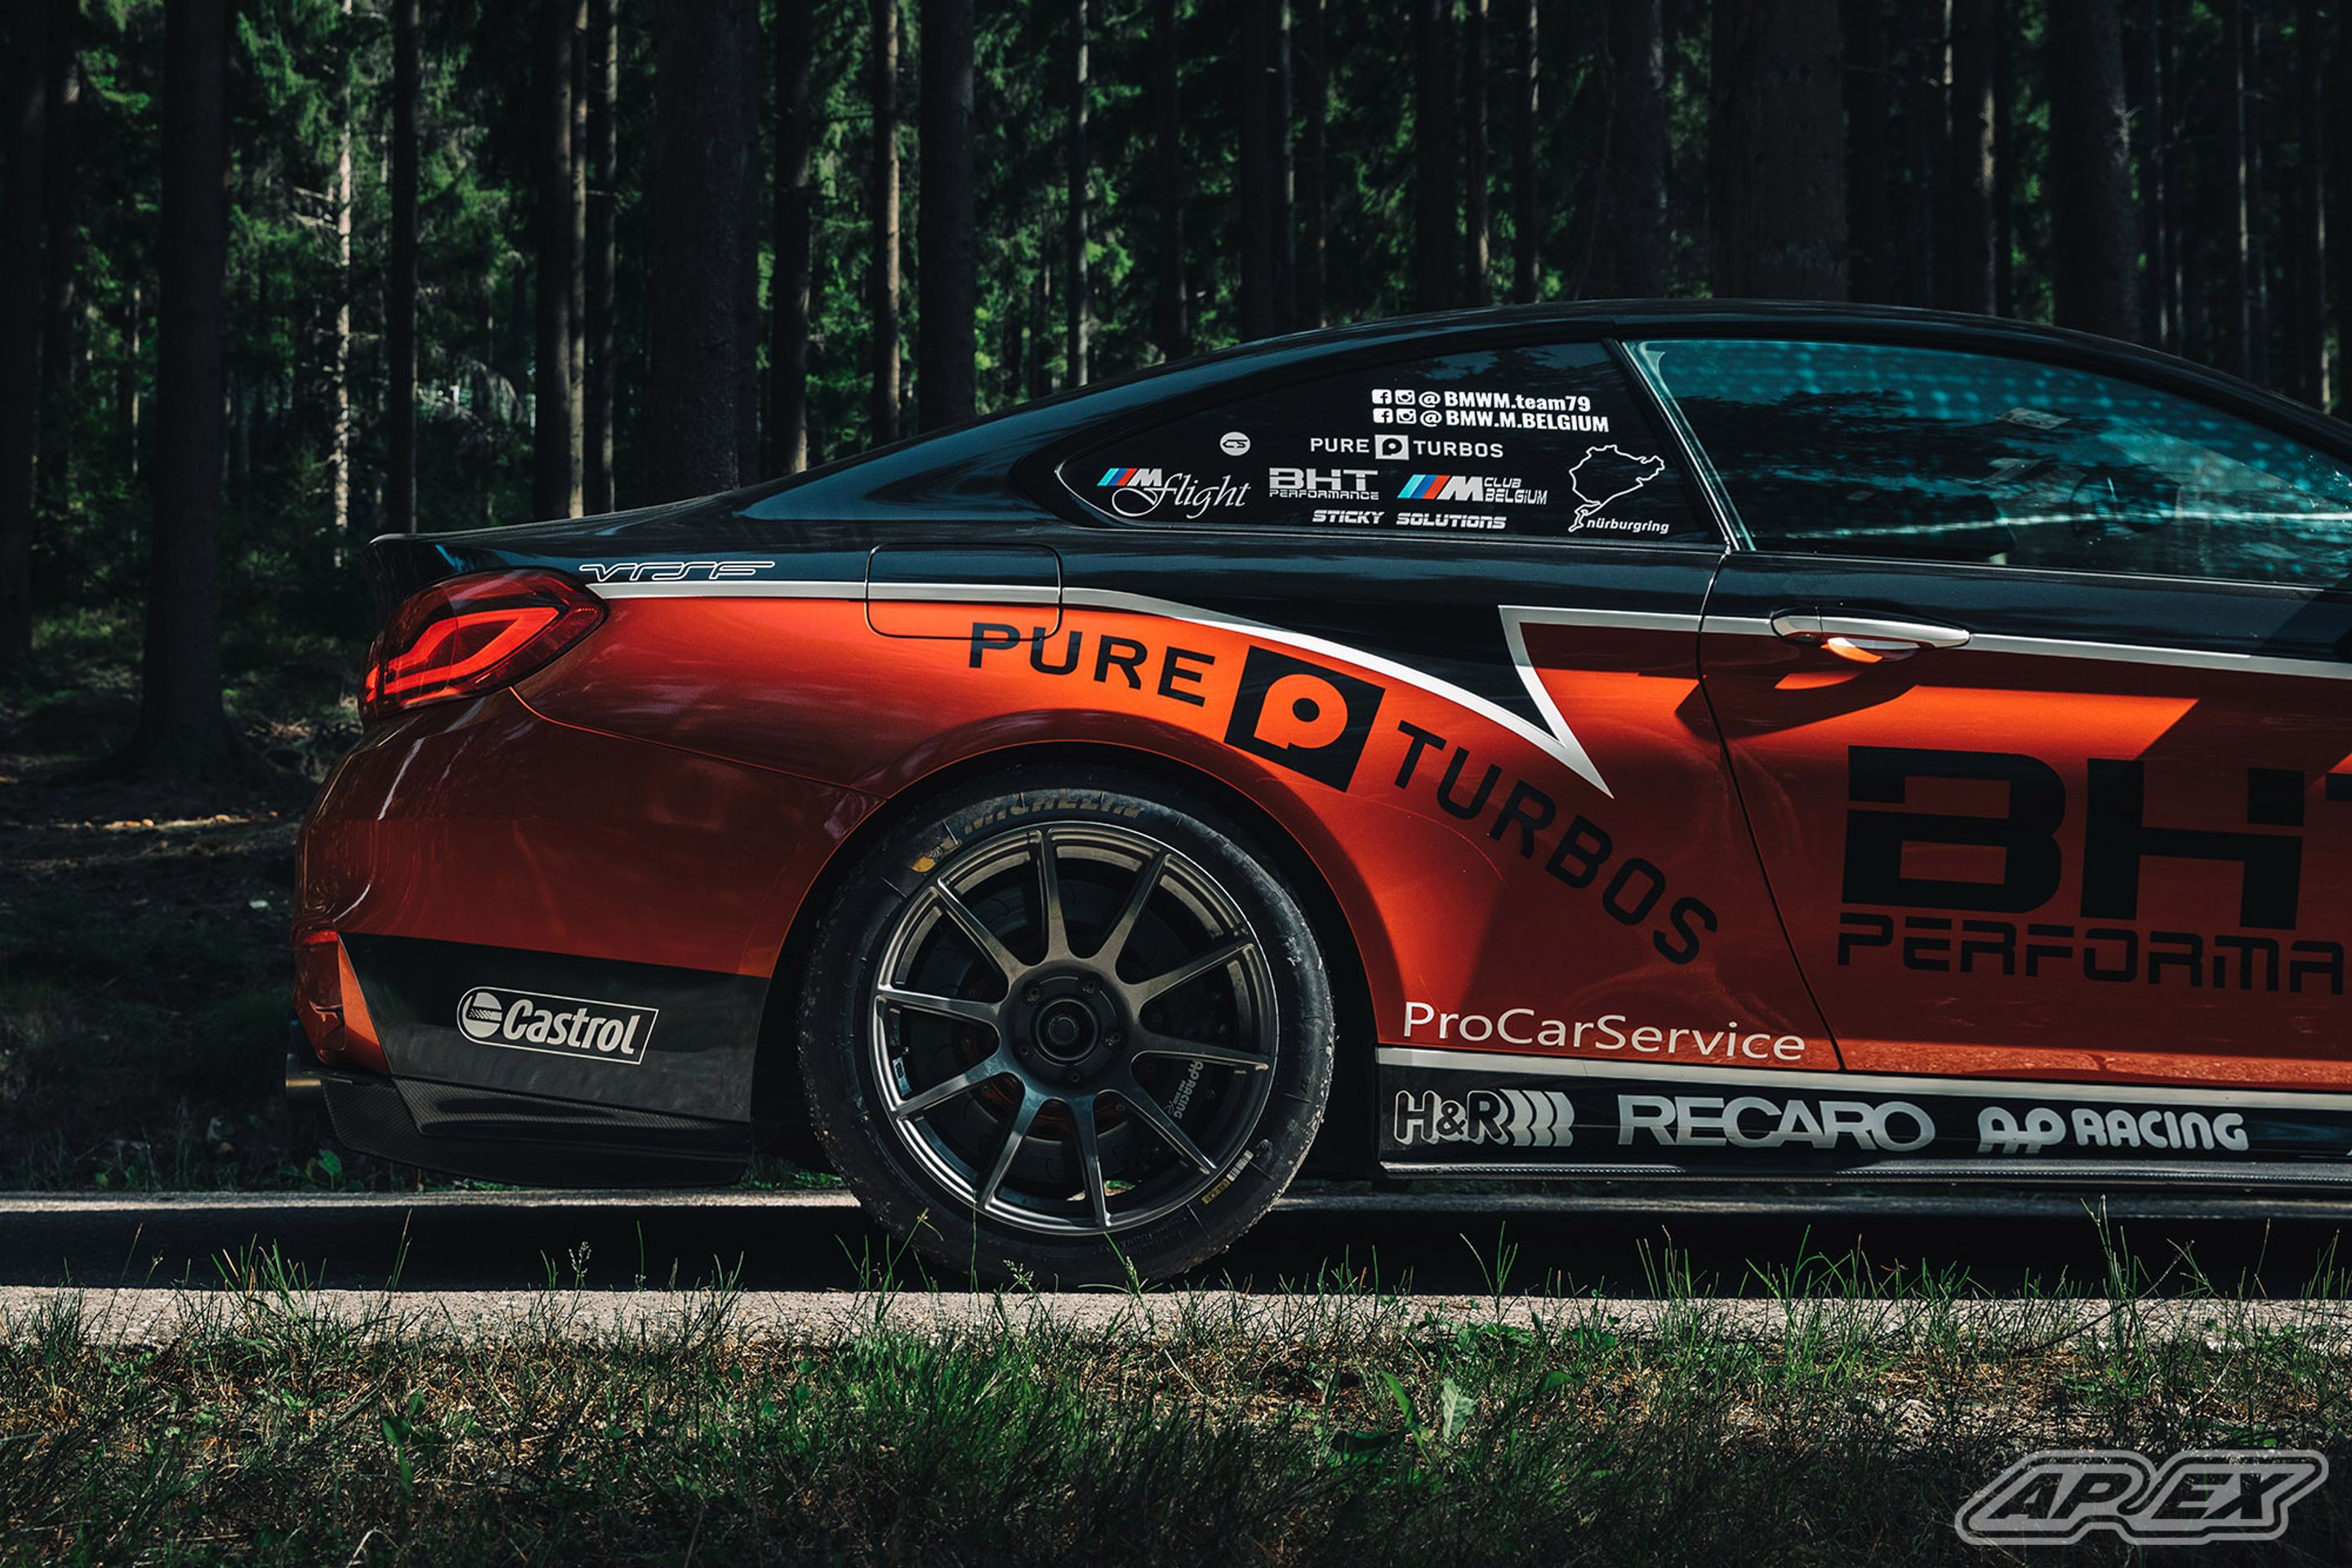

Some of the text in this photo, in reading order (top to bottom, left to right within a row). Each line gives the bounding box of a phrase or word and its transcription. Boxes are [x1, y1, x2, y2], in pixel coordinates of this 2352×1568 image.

[1444, 391, 1591, 412] BMWM.team79
[1446, 410, 1609, 433] BMW.M.BELGIUM
[1310, 437, 1370, 452] PURE
[1413, 440, 1503, 458] TURBOS
[1111, 472, 1251, 519] flight
[1269, 467, 1379, 491] BHT
[1269, 489, 1379, 501] PERFORMANCE
[1484, 477, 1522, 488] CLUB
[1312, 509, 1507, 529] STICKY SOLUTIONS
[1586, 518, 1670, 534] nürburgring
[969, 622, 1215, 707] PURE
[1395, 719, 1719, 965] TURBOS
[1842, 745, 2352, 930] BH
[1837, 912, 2345, 996] PERFORMA
[502, 999, 639, 1055] Castrol
[1402, 1001, 1806, 1061] ProCarService
[1173, 1079, 1196, 1120] RACING
[1393, 1089, 1508, 1145] H&R
[1618, 1095, 1936, 1152] RECARO
[2072, 1107, 2250, 1151] RACING
